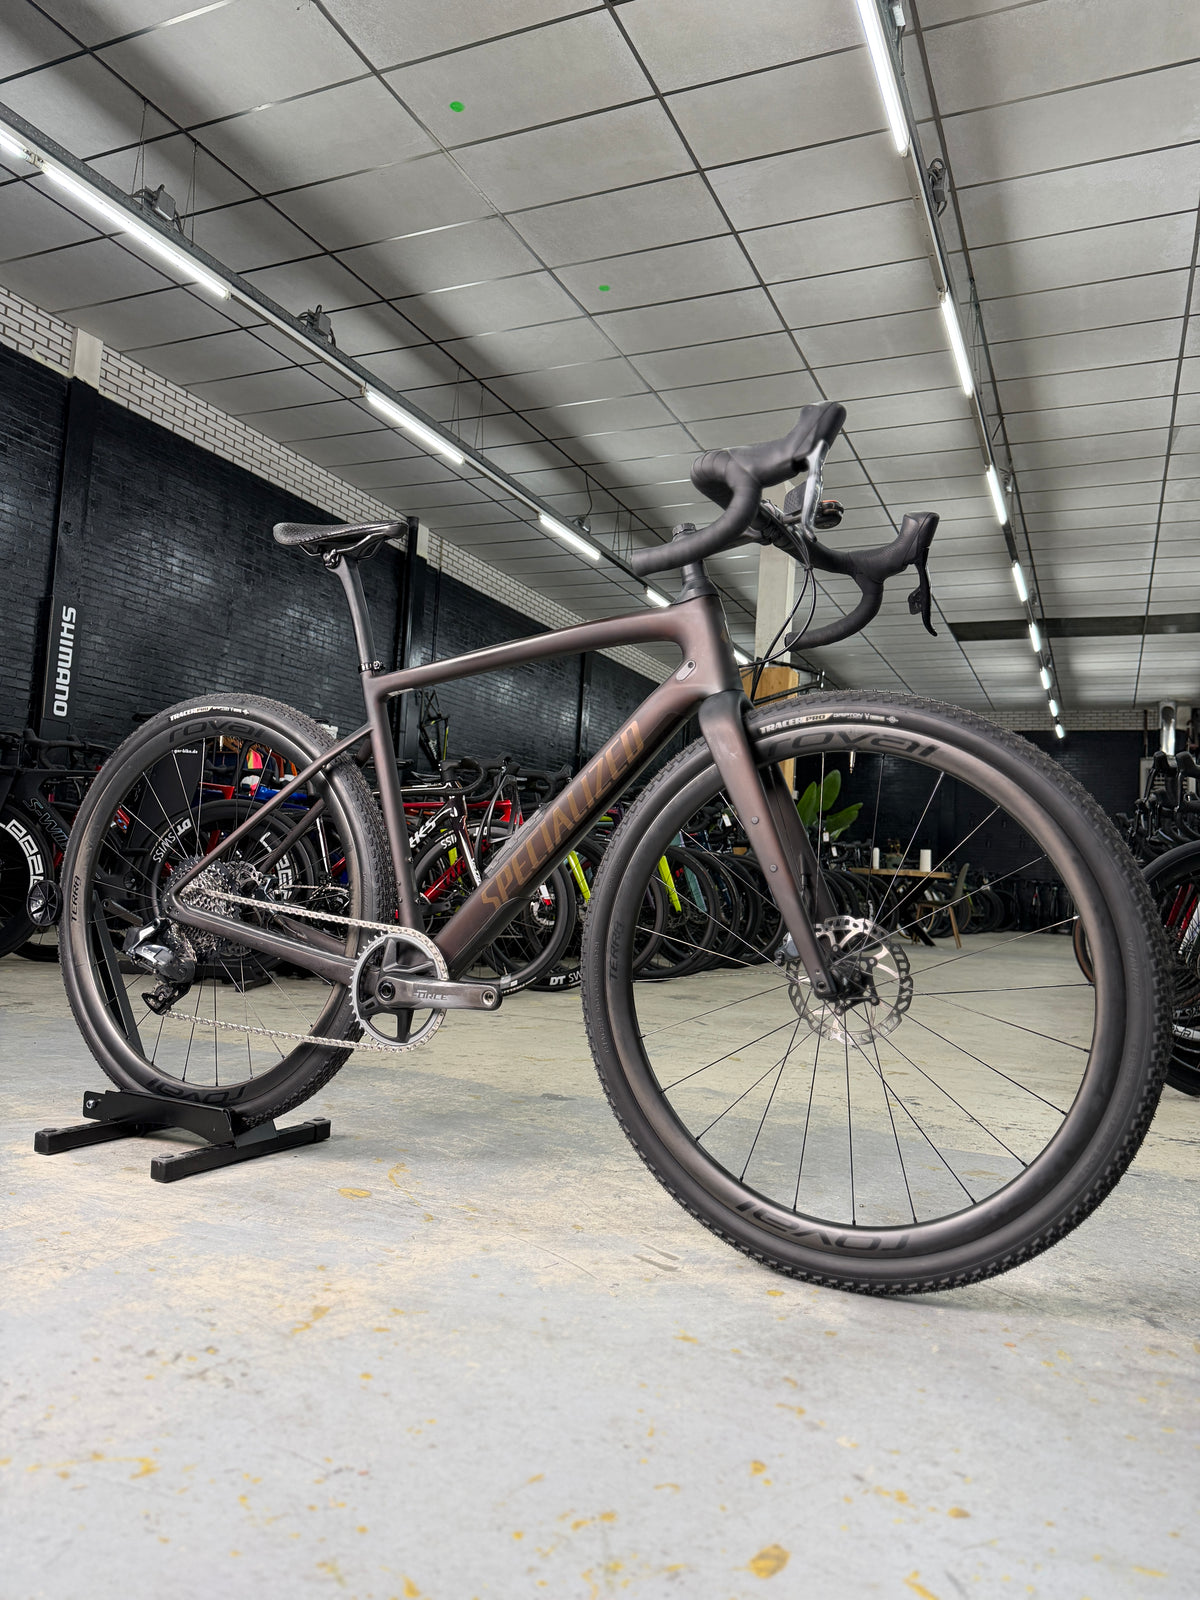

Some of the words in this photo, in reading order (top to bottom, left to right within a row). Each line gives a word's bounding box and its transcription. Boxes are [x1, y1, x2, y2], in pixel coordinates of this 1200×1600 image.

[53, 605, 77, 717] SHIMANO
[759, 717, 803, 734] TRACER
[805, 714, 827, 722] PRO
[176, 818, 192, 836] DT
[481, 720, 645, 910] SPECIALIZED
[152, 831, 177, 863] SWISS
[71, 875, 81, 921] TERRA
[609, 921, 623, 980] TERRA
[549, 975, 567, 986] DT
